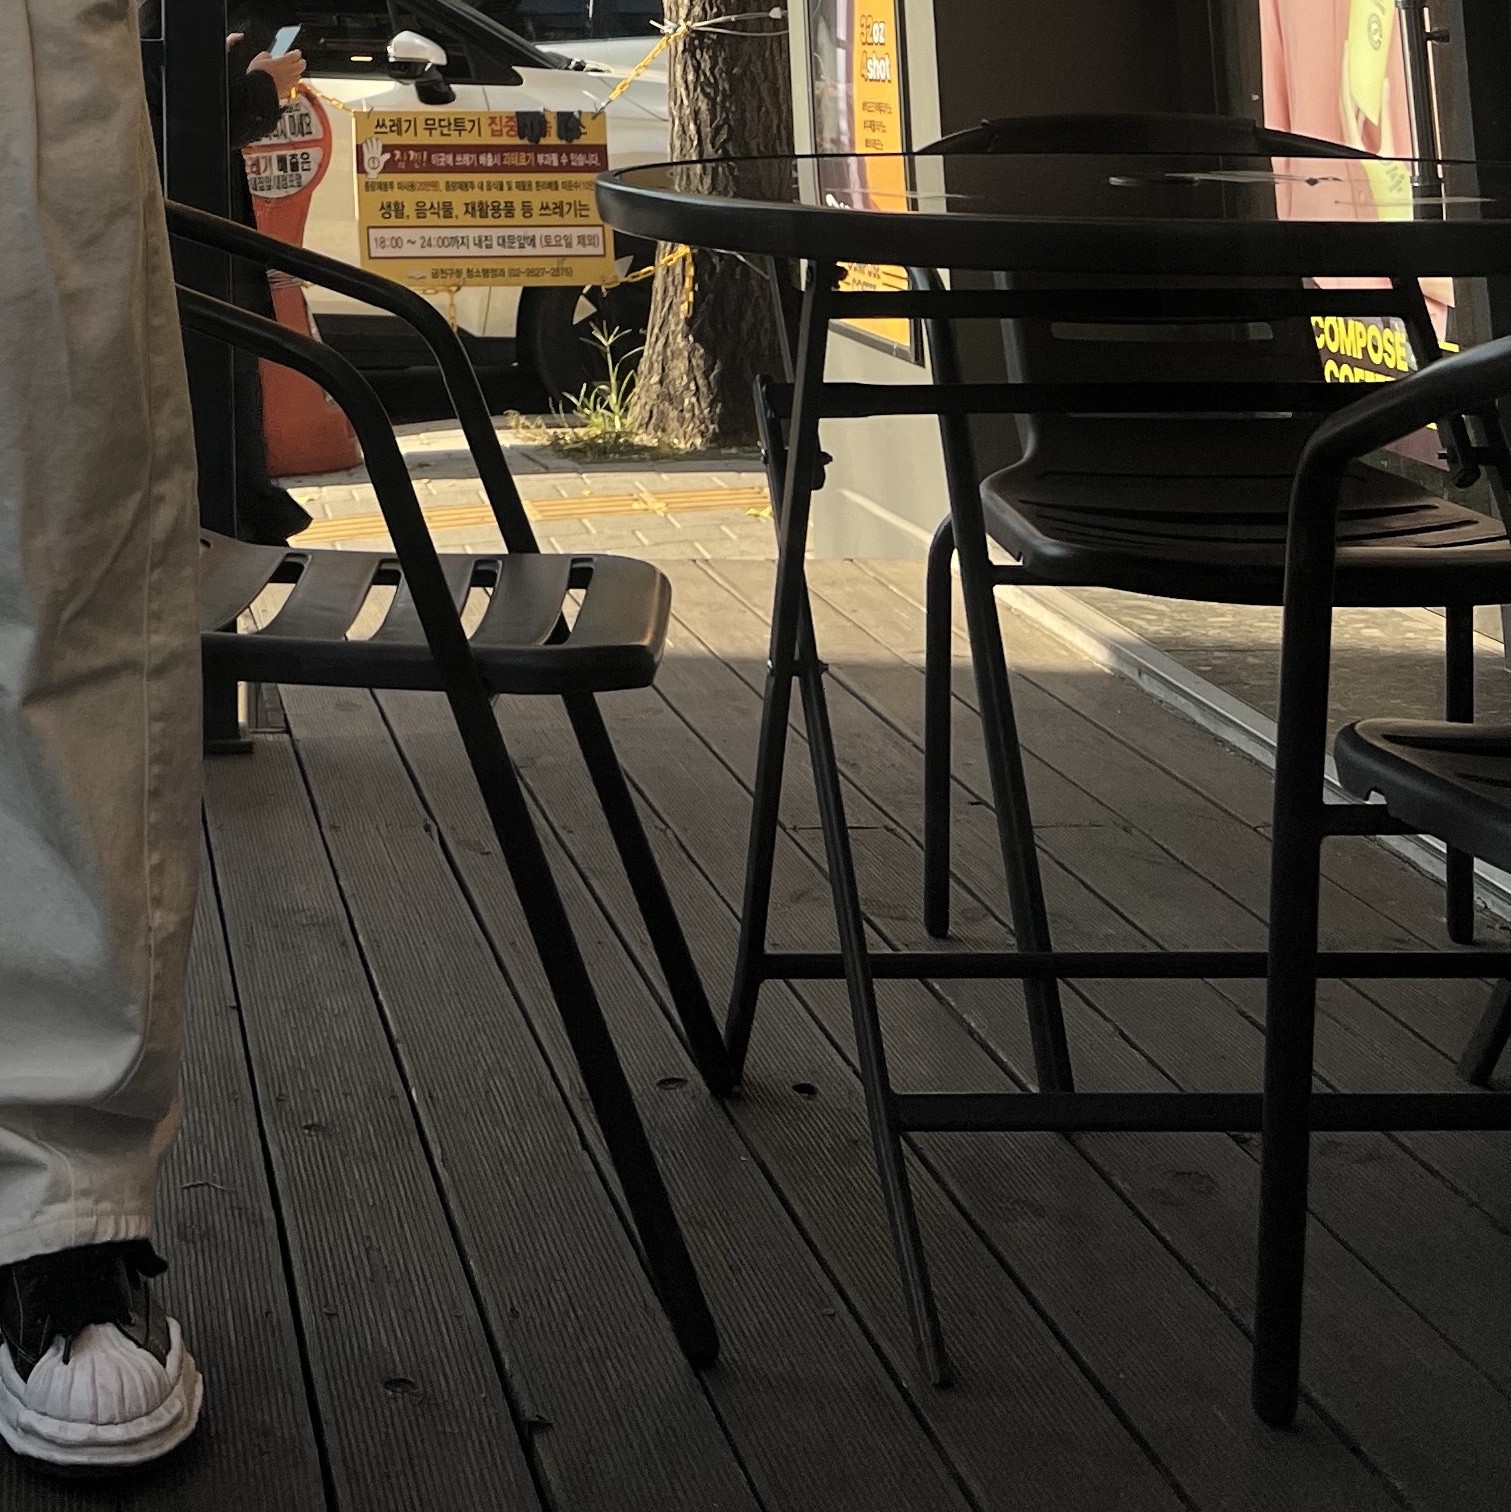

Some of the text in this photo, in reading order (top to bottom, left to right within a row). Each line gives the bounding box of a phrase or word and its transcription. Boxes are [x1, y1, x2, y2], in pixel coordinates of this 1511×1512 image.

[859, 14, 886, 46] 32oz
[859, 50, 892, 83] 4shot
[373, 117, 418, 137] 쓰레기
[423, 117, 482, 137] 무단투기
[394, 150, 427, 169] 잠깐!
[455, 152, 477, 166] 쓰레기
[560, 152, 568, 166] 수
[569, 153, 601, 167] 있습니다.
[378, 200, 591, 219] 생활, 음식물, 재활용품 등 쓰레기는
[373, 236, 403, 250] 18:00
[420, 236, 470, 250] 24:00까지
[473, 235, 494, 250] 내집
[496, 234, 537, 250] 대문앞에
[539, 233, 574, 249] (토요일
[576, 232, 600, 250] 제외)
[1310, 316, 1409, 372] COMPOSE
